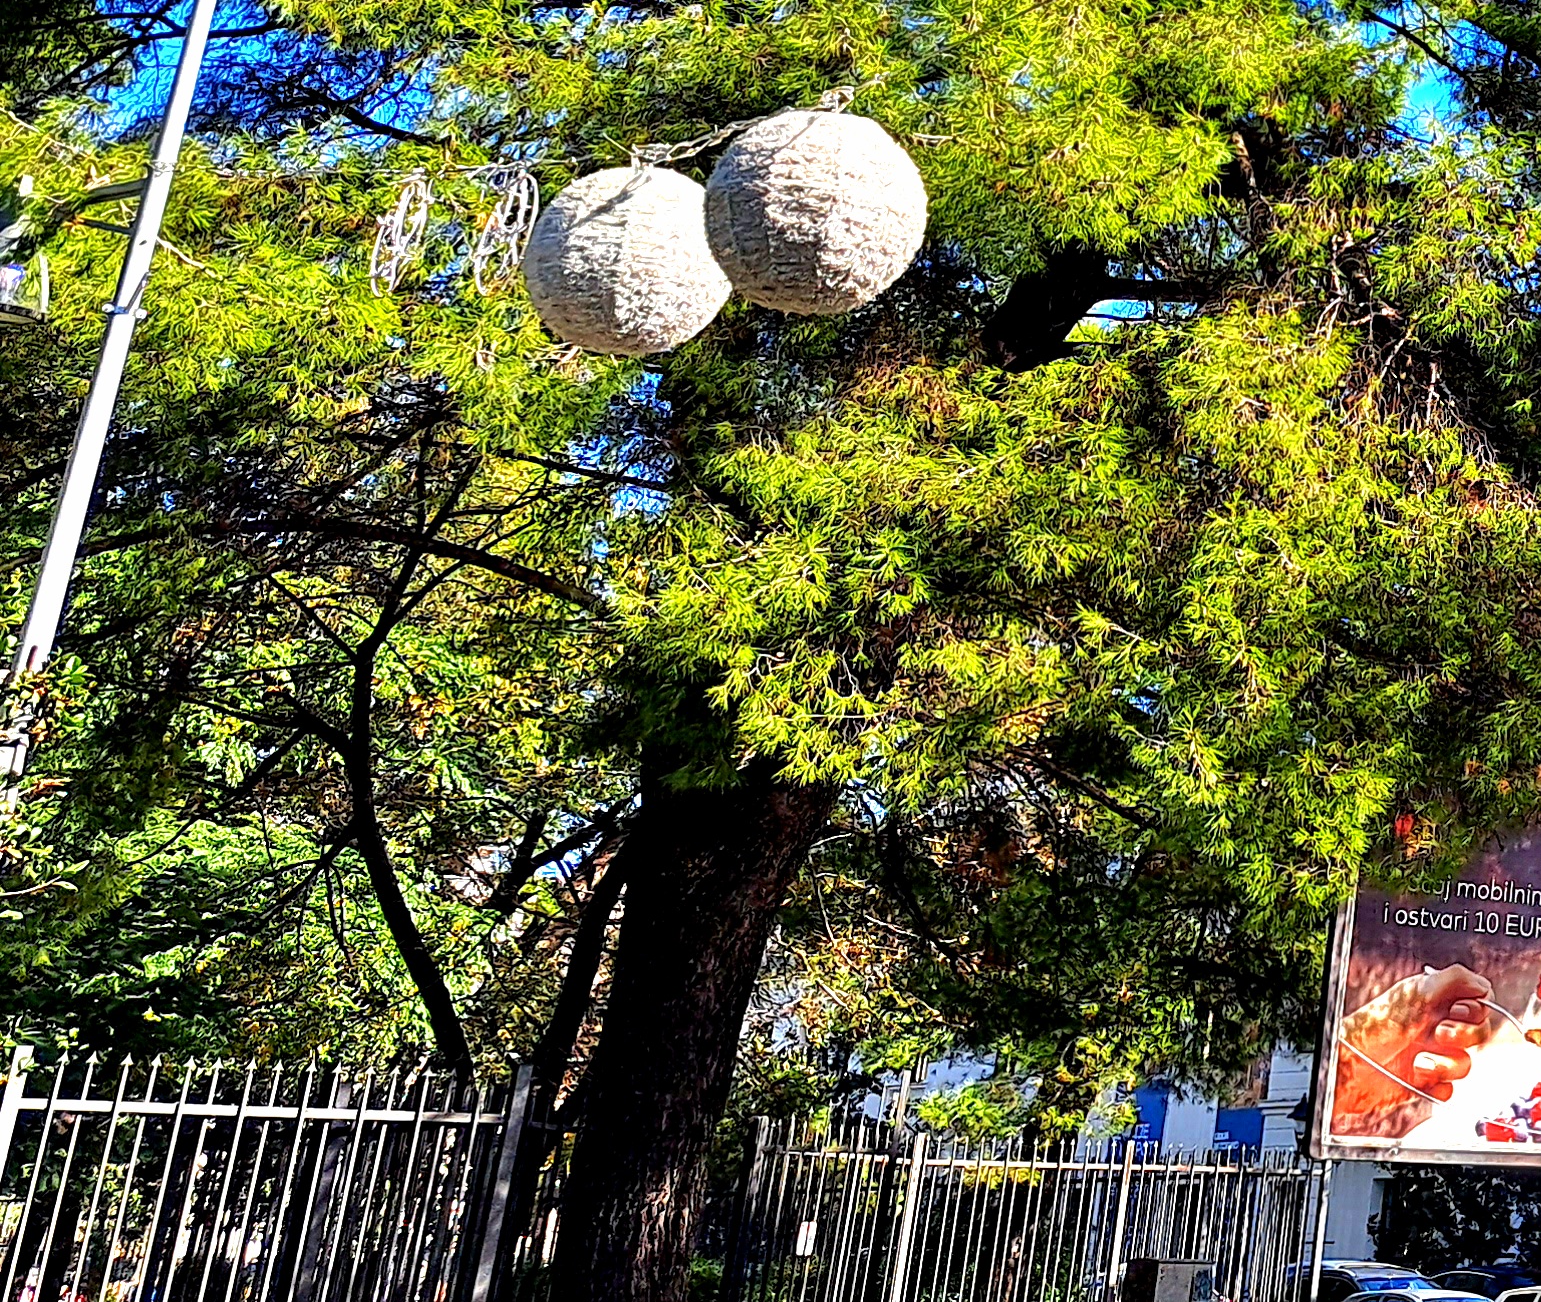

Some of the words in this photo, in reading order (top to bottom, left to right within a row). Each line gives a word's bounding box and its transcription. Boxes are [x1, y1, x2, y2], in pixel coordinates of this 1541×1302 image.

[1382, 901, 1390, 924] i
[1395, 906, 1469, 931] ostvari
[1474, 911, 1499, 934] 10
